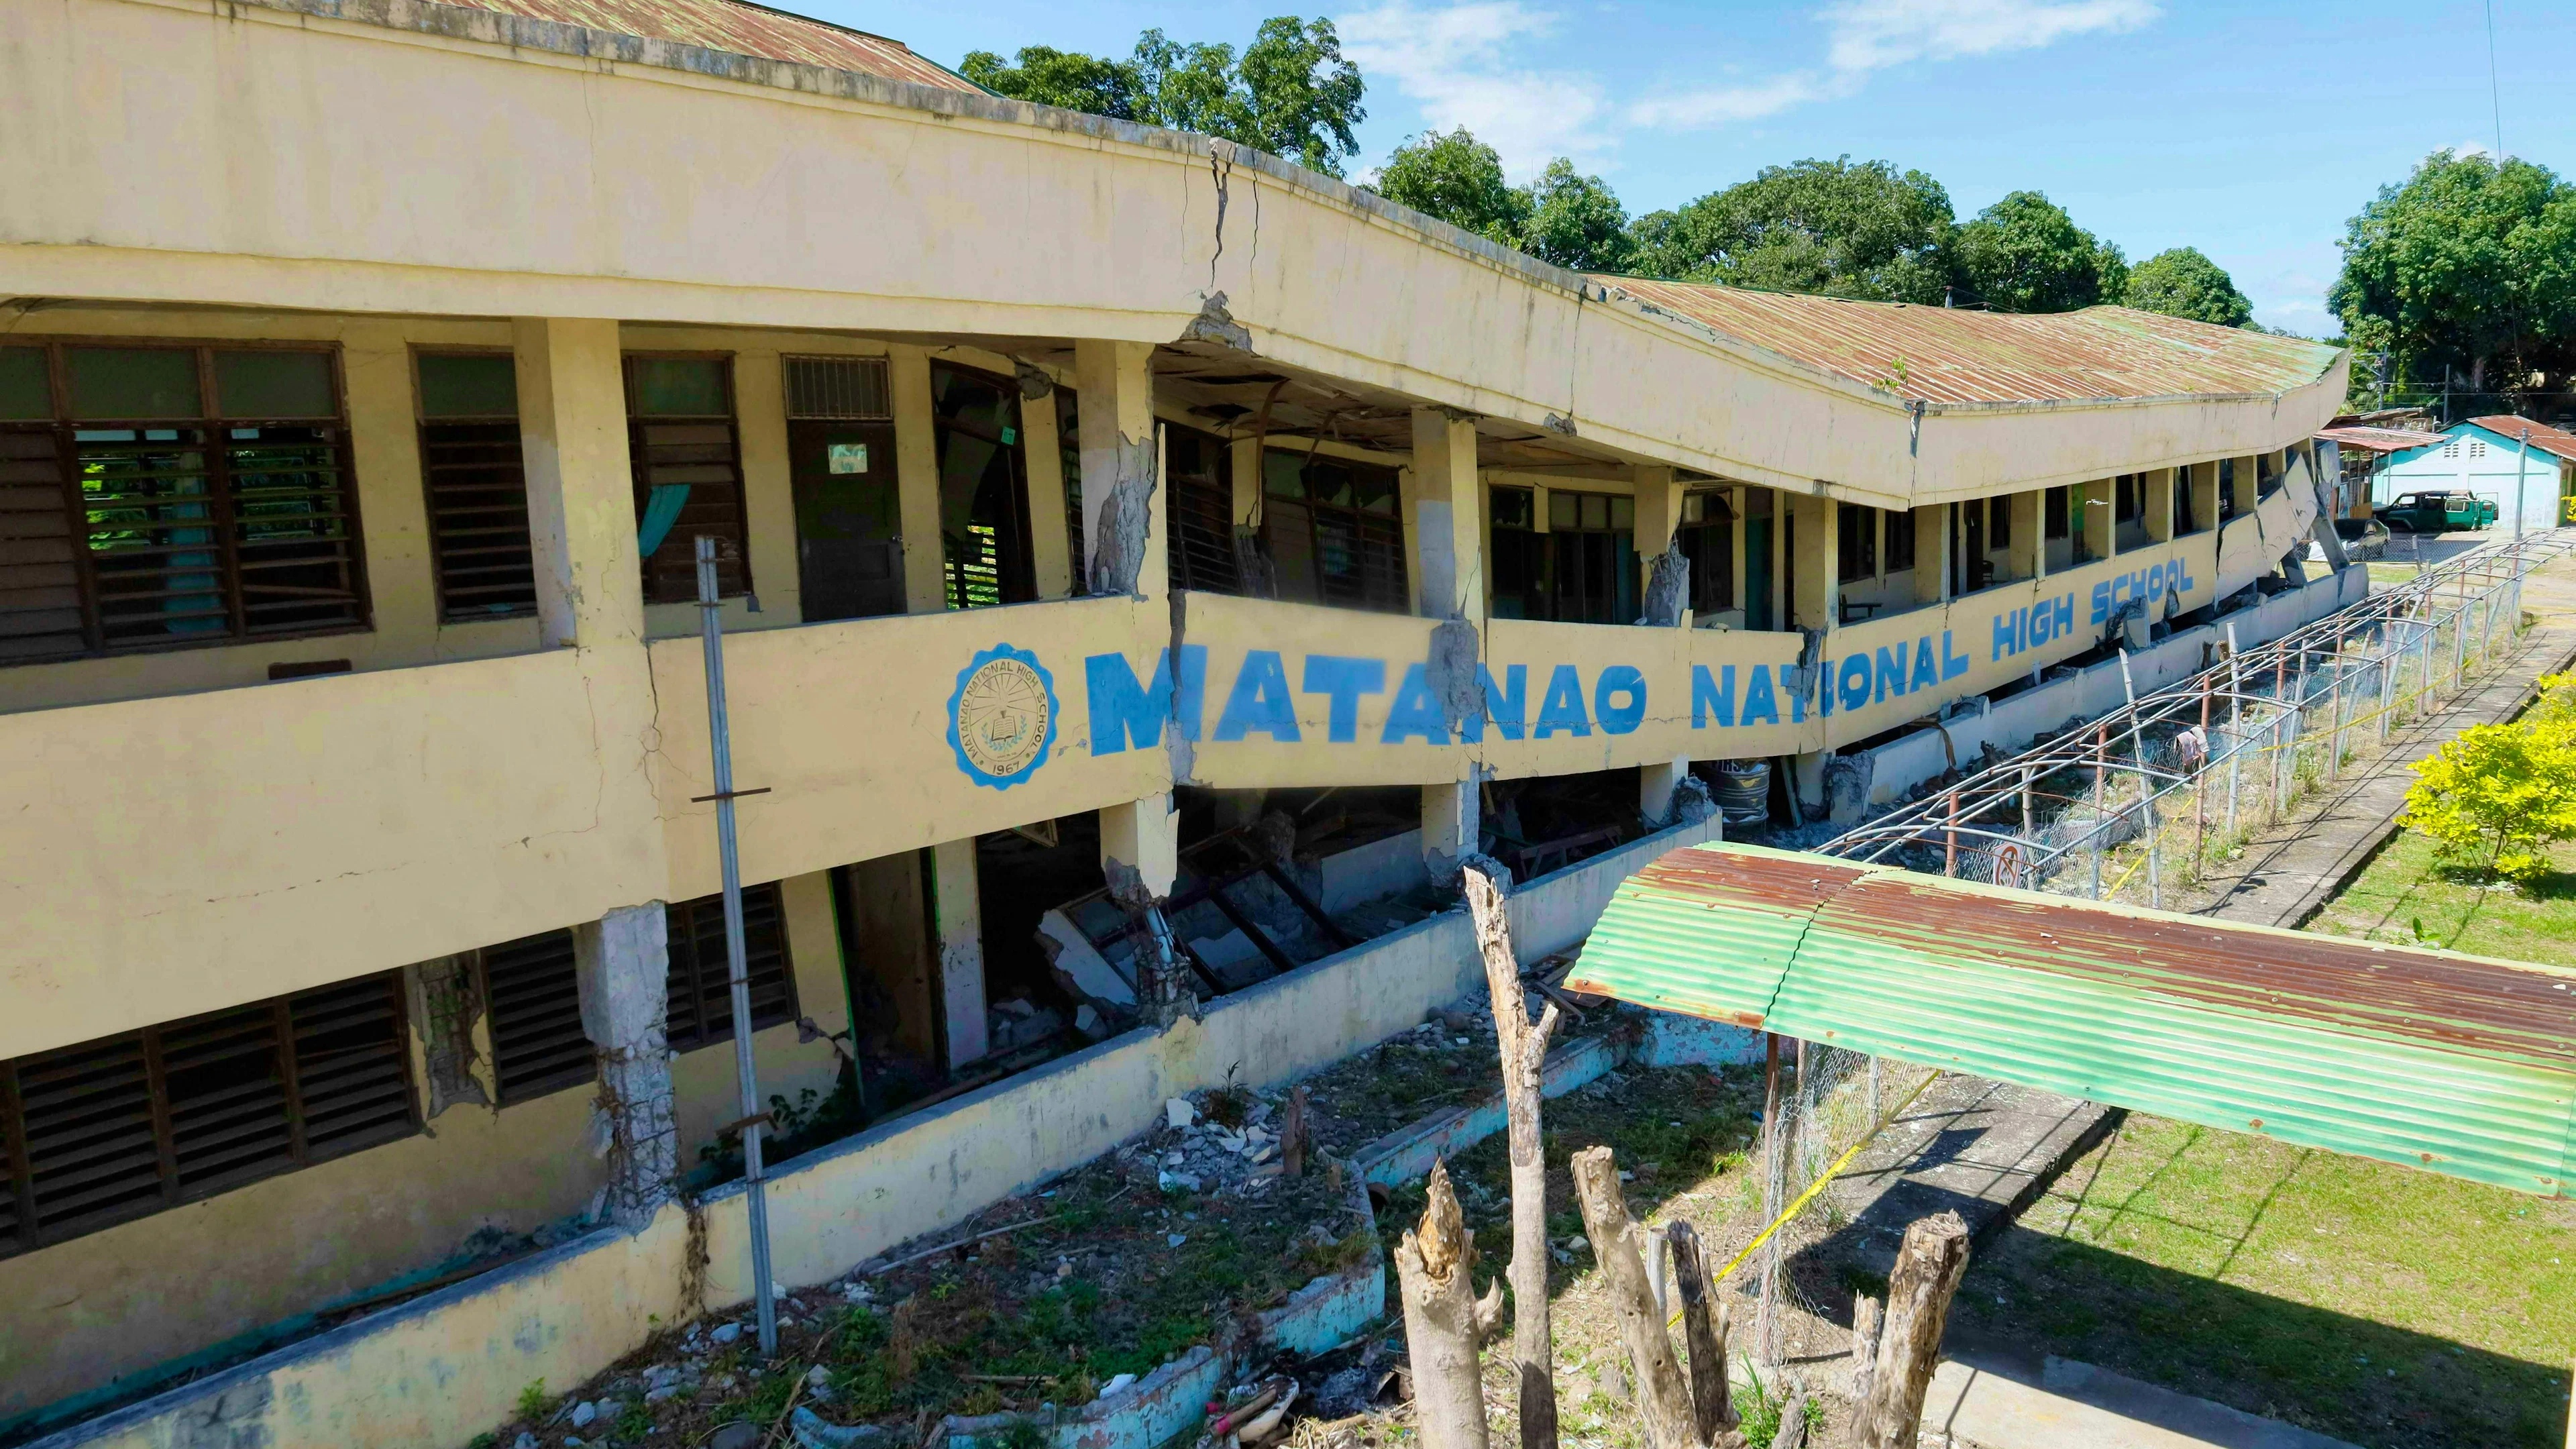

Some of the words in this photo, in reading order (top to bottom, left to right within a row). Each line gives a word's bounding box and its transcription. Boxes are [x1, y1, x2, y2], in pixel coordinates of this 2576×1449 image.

[967, 661, 1013, 696] NATIONAL
[1017, 664, 1038, 687] HIGH
[1085, 645, 1648, 757] MATANAO
[1992, 592, 2074, 662] HIGH
[2091, 557, 2193, 625] SCHOOL
[960, 699, 978, 759] MATANAO
[1030, 693, 1046, 747] SCHOOL
[993, 761, 1020, 775] 1967
